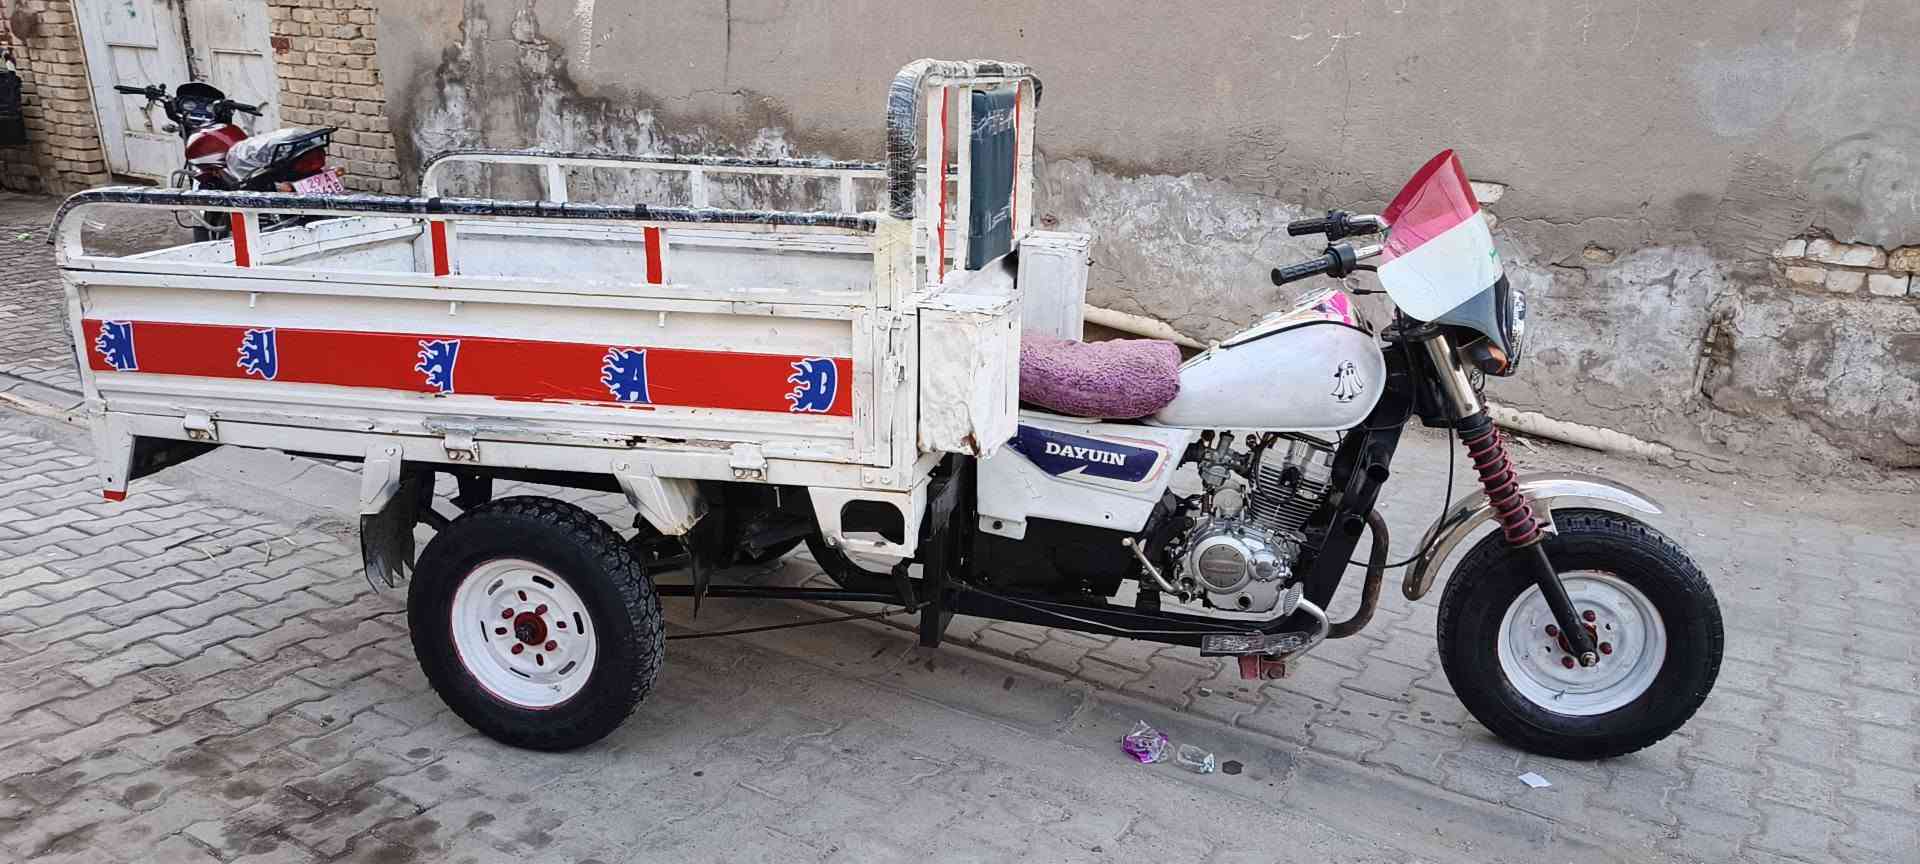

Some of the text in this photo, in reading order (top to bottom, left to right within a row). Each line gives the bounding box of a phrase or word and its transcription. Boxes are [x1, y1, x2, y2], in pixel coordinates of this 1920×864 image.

[237, 327, 278, 381] U
[414, 339, 461, 393] Y
[600, 347, 652, 404] A
[785, 357, 838, 413] D
[1044, 441, 1127, 466] DAYUIN
